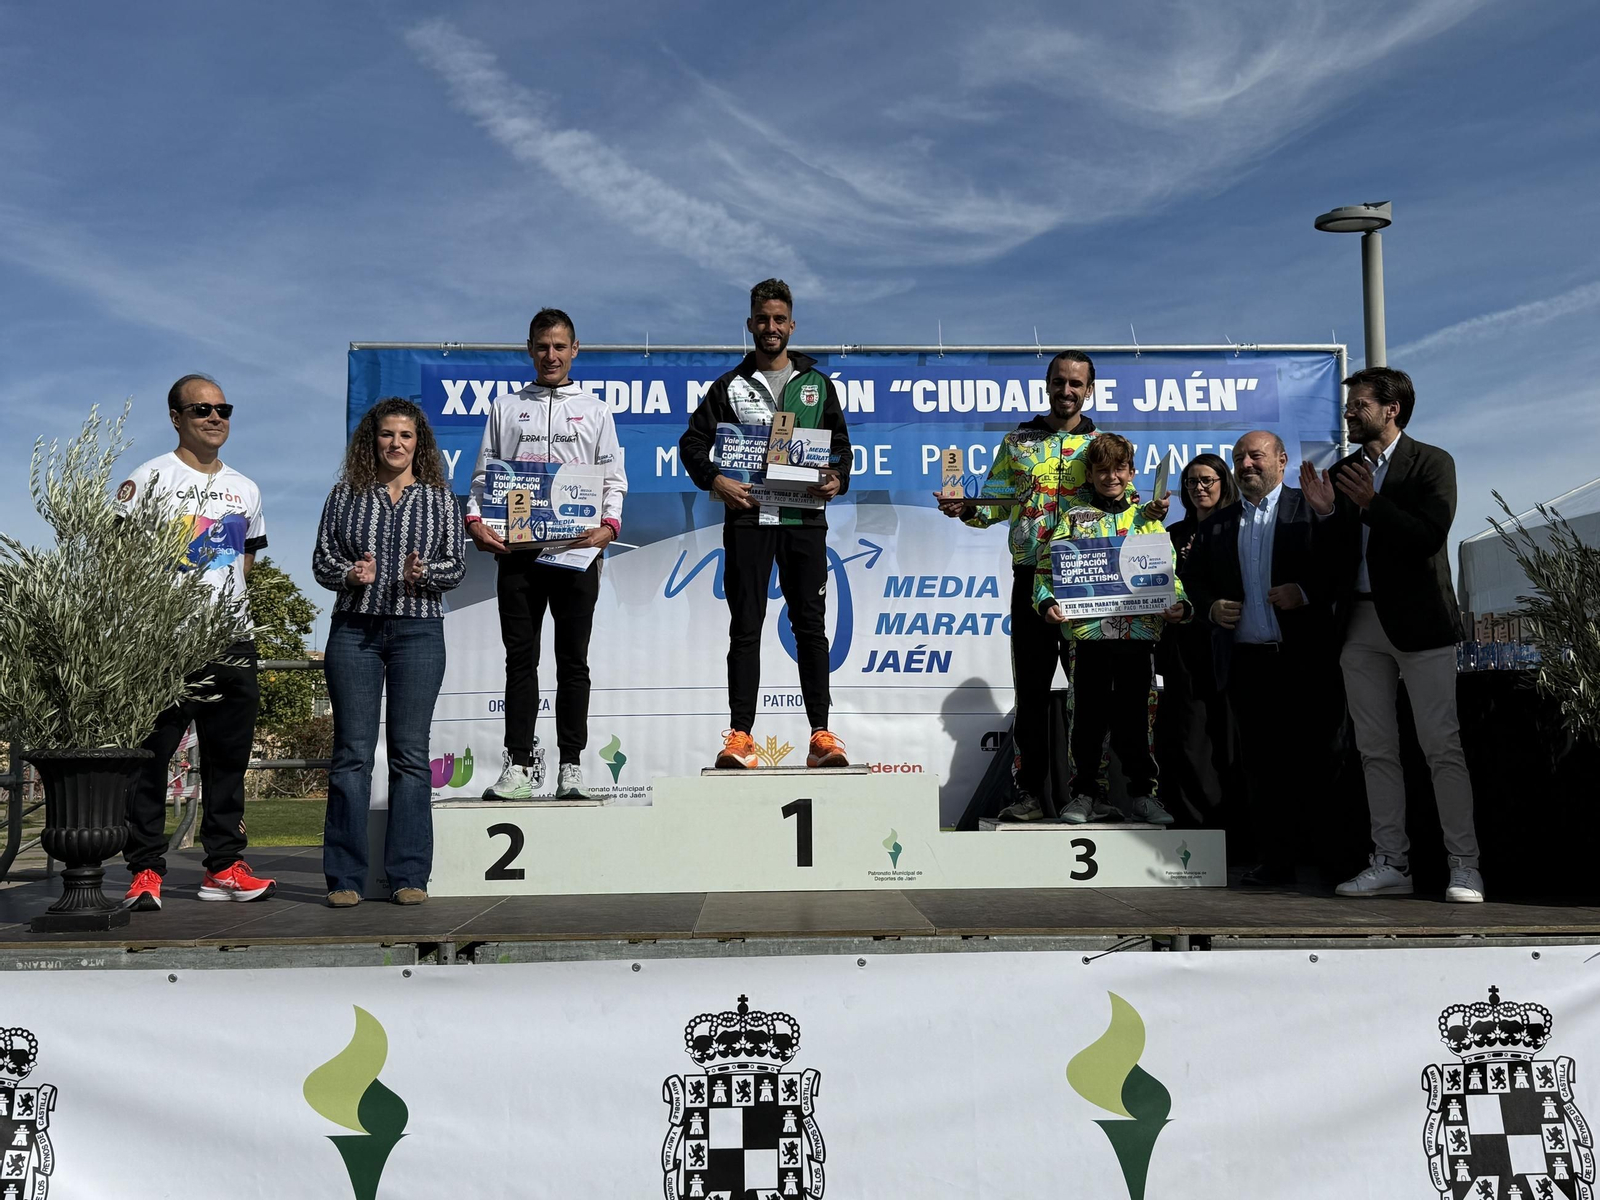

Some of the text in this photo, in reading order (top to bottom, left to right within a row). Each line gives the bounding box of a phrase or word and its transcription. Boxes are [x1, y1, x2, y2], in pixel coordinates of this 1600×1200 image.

[581, 381, 671, 414] EDIA
[1080, 379, 1119, 412] E
[1133, 371, 1258, 412] JAÉN”
[781, 415, 786, 427] 1
[724, 437, 739, 445] Vale
[740, 439, 753, 447] por
[442, 449, 462, 480] Y
[851, 445, 893, 475] DE
[721, 460, 735, 468] DE
[722, 452, 763, 462] COMPLETA
[948, 453, 957, 464] 3
[493, 481, 540, 491] EQUIPACIÓN
[512, 475, 525, 483] por
[514, 493, 525, 505] 2
[1060, 559, 1108, 569] EQUIPACIÓN
[1078, 553, 1091, 561] por
[1074, 574, 1119, 583] ATLETISMO
[883, 576, 999, 598] MEDIA
[861, 644, 953, 673] JAÉN
[612, 785, 645, 793] Municipal
[781, 797, 813, 867] 1
[485, 822, 526, 881] 2
[1069, 837, 1099, 881] 3
[1430, 1070, 1438, 1083] MUY
[1556, 1064, 1566, 1098] CASTILLA
[671, 1081, 681, 1120] MUY NOBLE
[803, 1076, 812, 1111] CASTILLA
[38, 1091, 49, 1126] CASTILLA
[1427, 1122, 1435, 1137] MUY
[1564, 1104, 1589, 1144] REYNOS DE
[666, 1136, 676, 1152] MUY
[804, 1118, 822, 1159] REYNOS DE
[37, 1132, 50, 1173] REYNOS DE
[1431, 1162, 1442, 1186] CIUDAD
[1585, 1166, 1592, 1180] DE
[38, 1179, 46, 1193] LOS
[813, 1184, 821, 1195] DE
